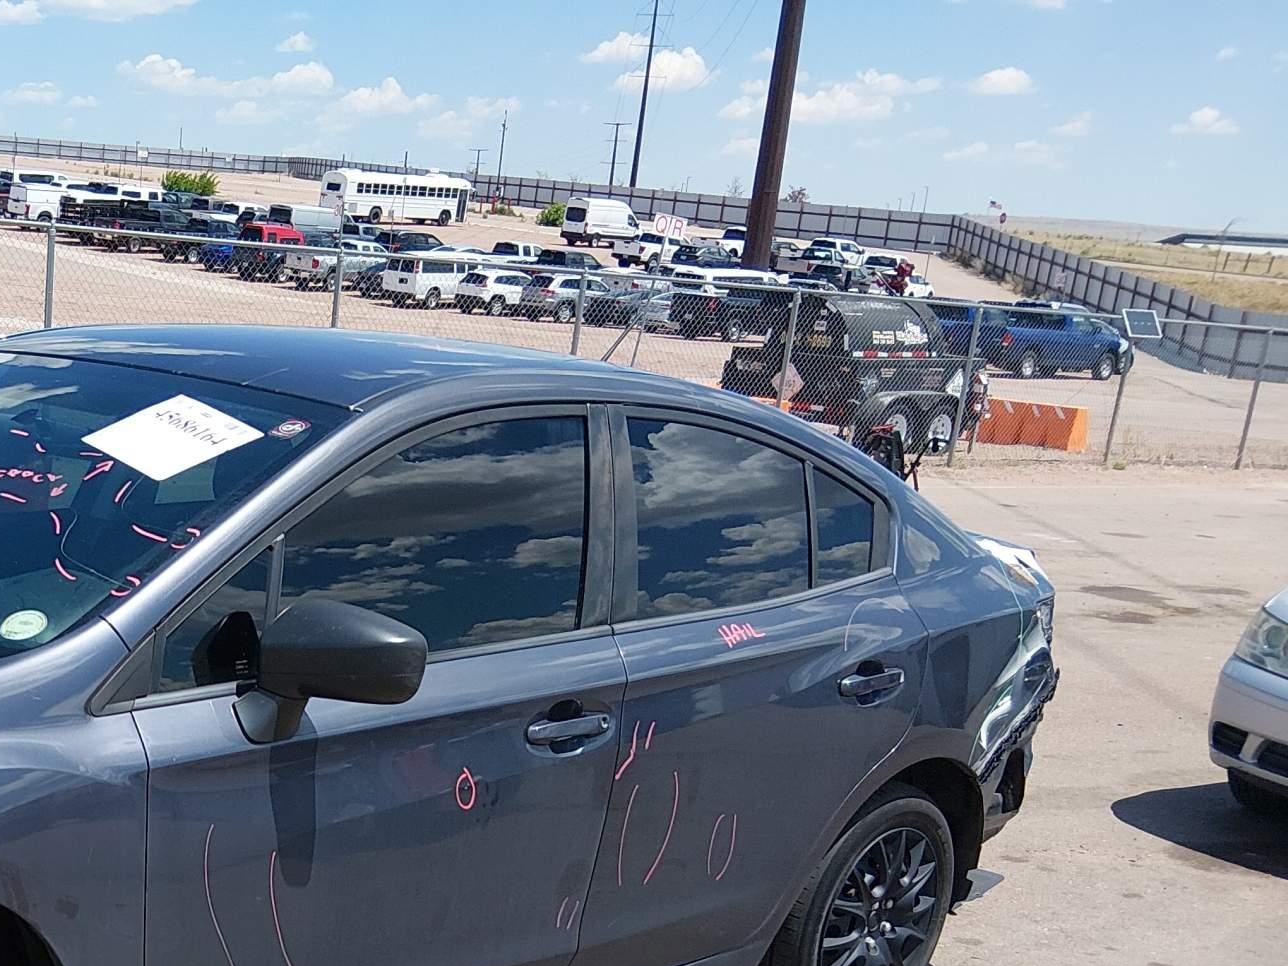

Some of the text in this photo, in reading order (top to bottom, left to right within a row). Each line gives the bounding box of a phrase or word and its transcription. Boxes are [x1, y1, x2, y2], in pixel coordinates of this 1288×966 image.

[656, 215, 684, 237] Q R
[717, 622, 767, 649] HAIL
